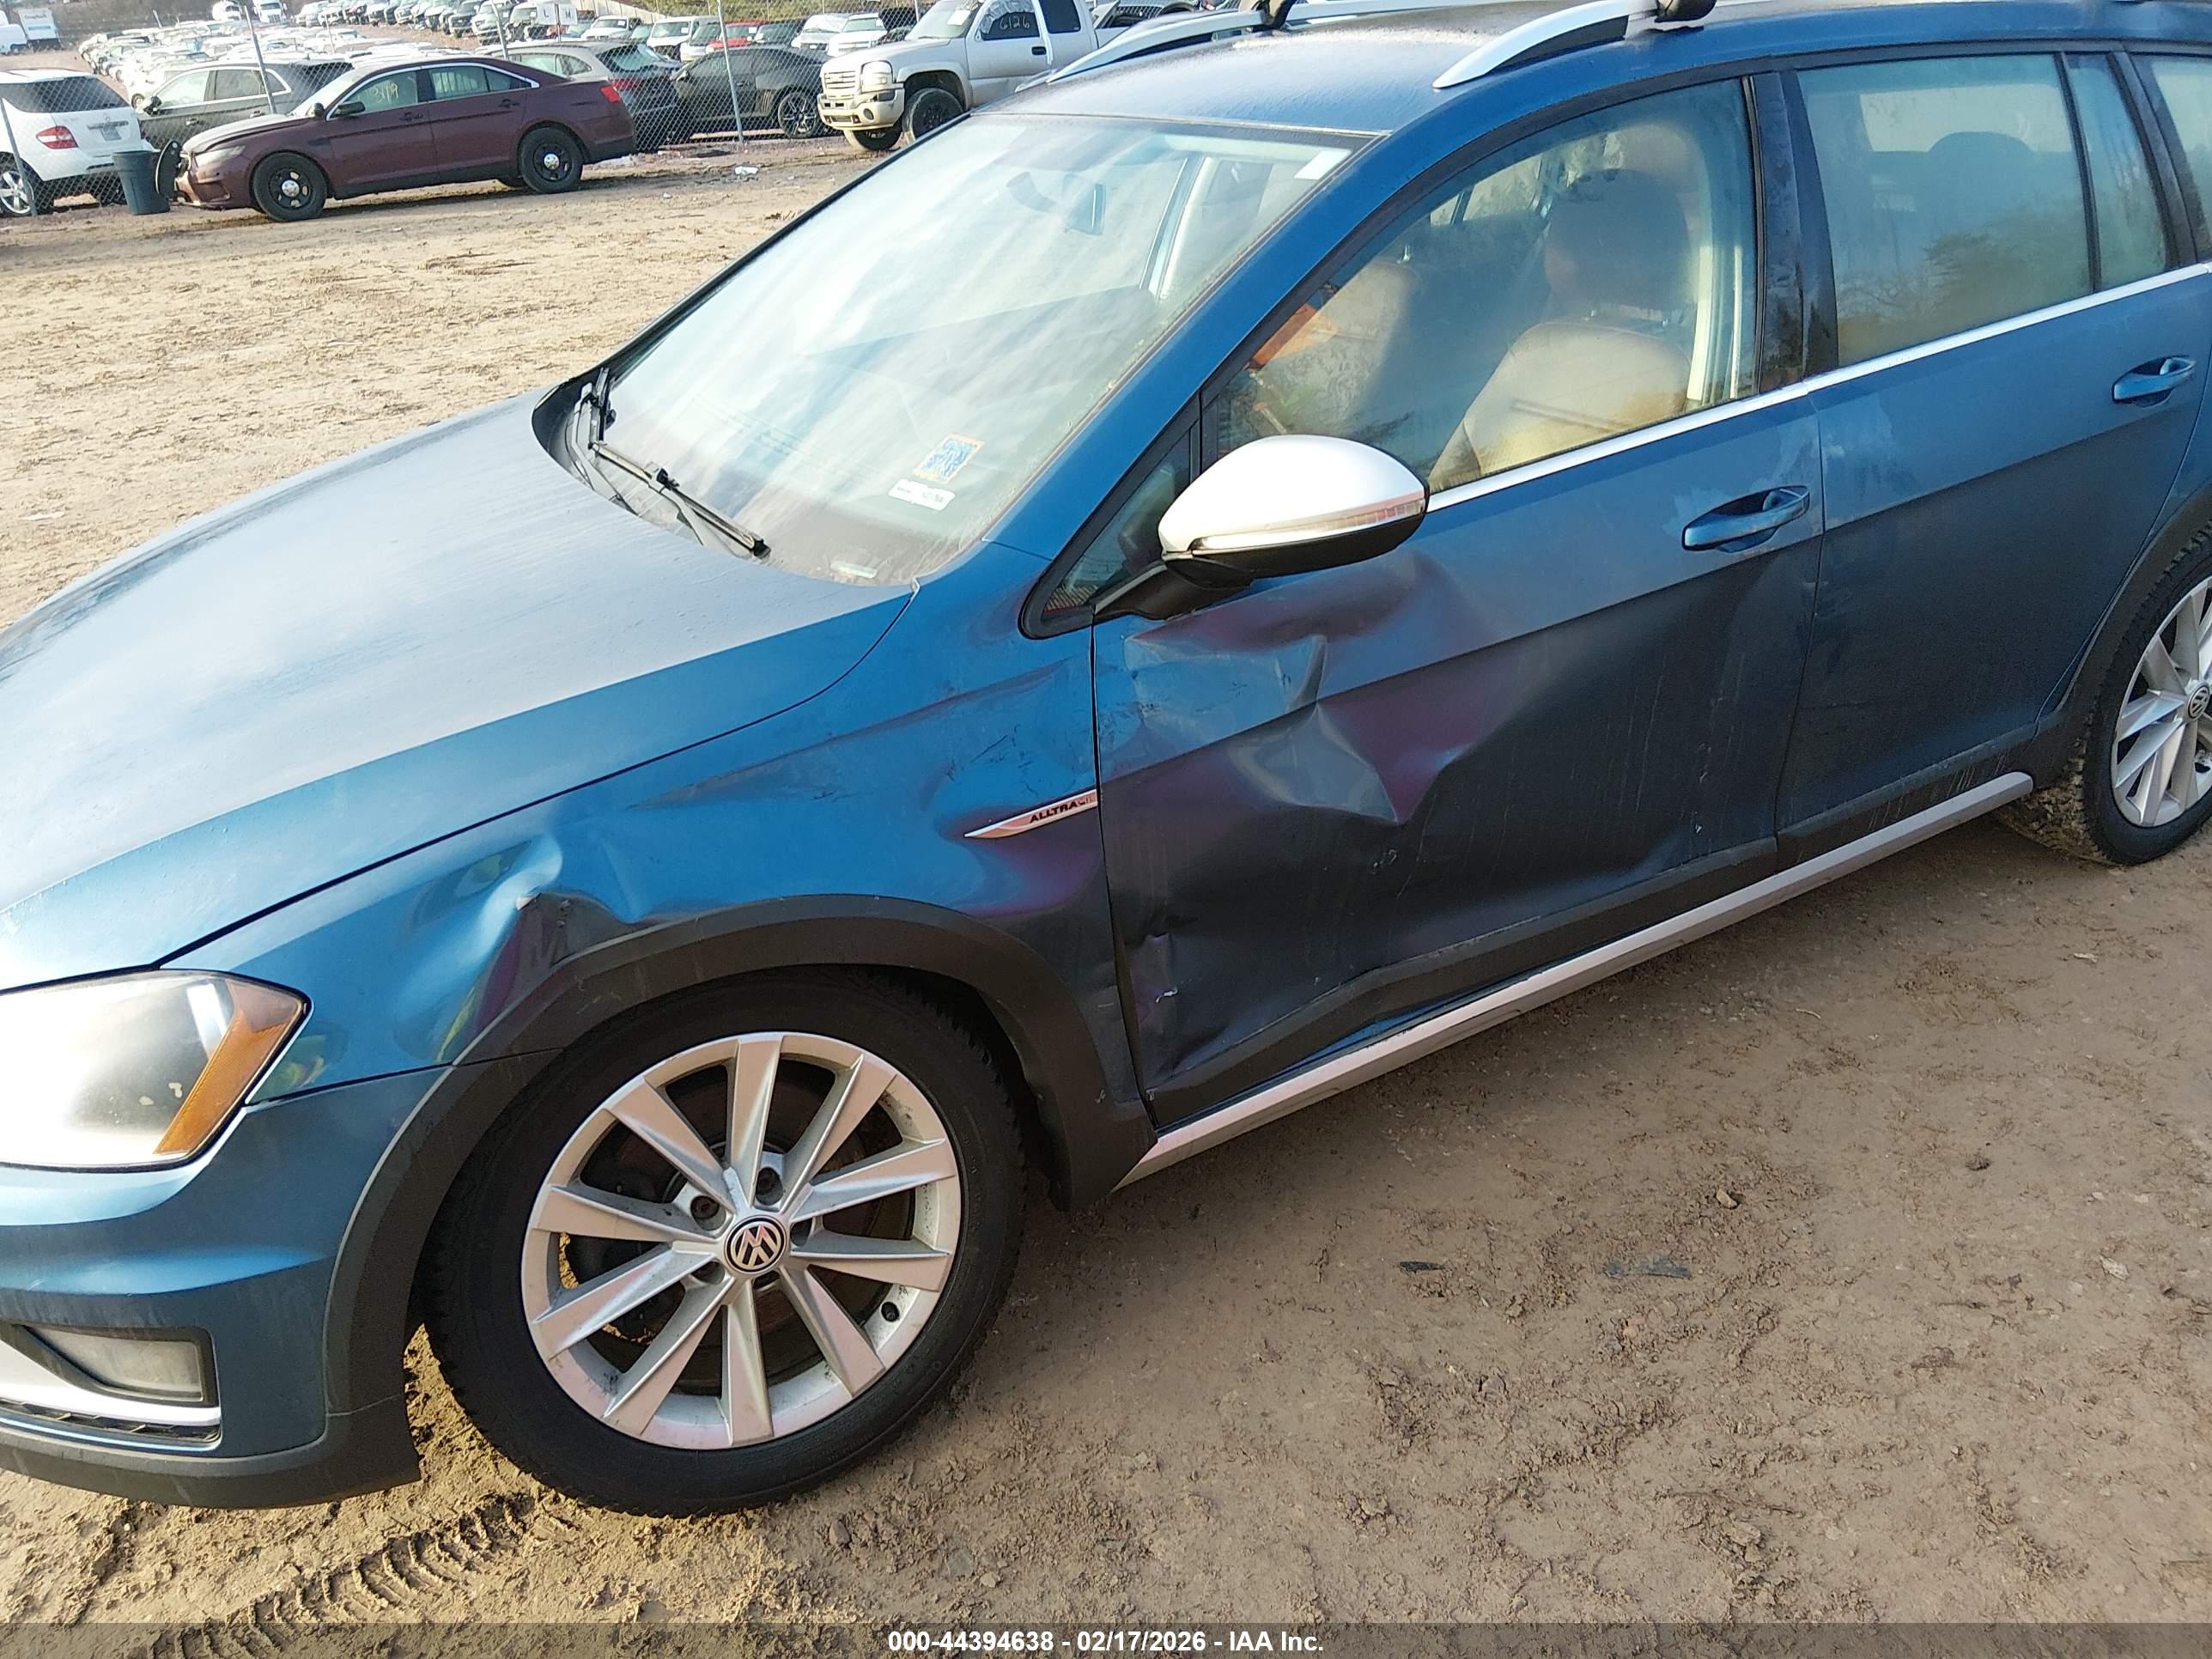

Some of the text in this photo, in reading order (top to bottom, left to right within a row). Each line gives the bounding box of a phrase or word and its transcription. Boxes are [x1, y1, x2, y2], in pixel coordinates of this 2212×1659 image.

[544, 9, 550, 18] L
[565, 10, 572, 19] M
[1000, 15, 1030, 30] 6126
